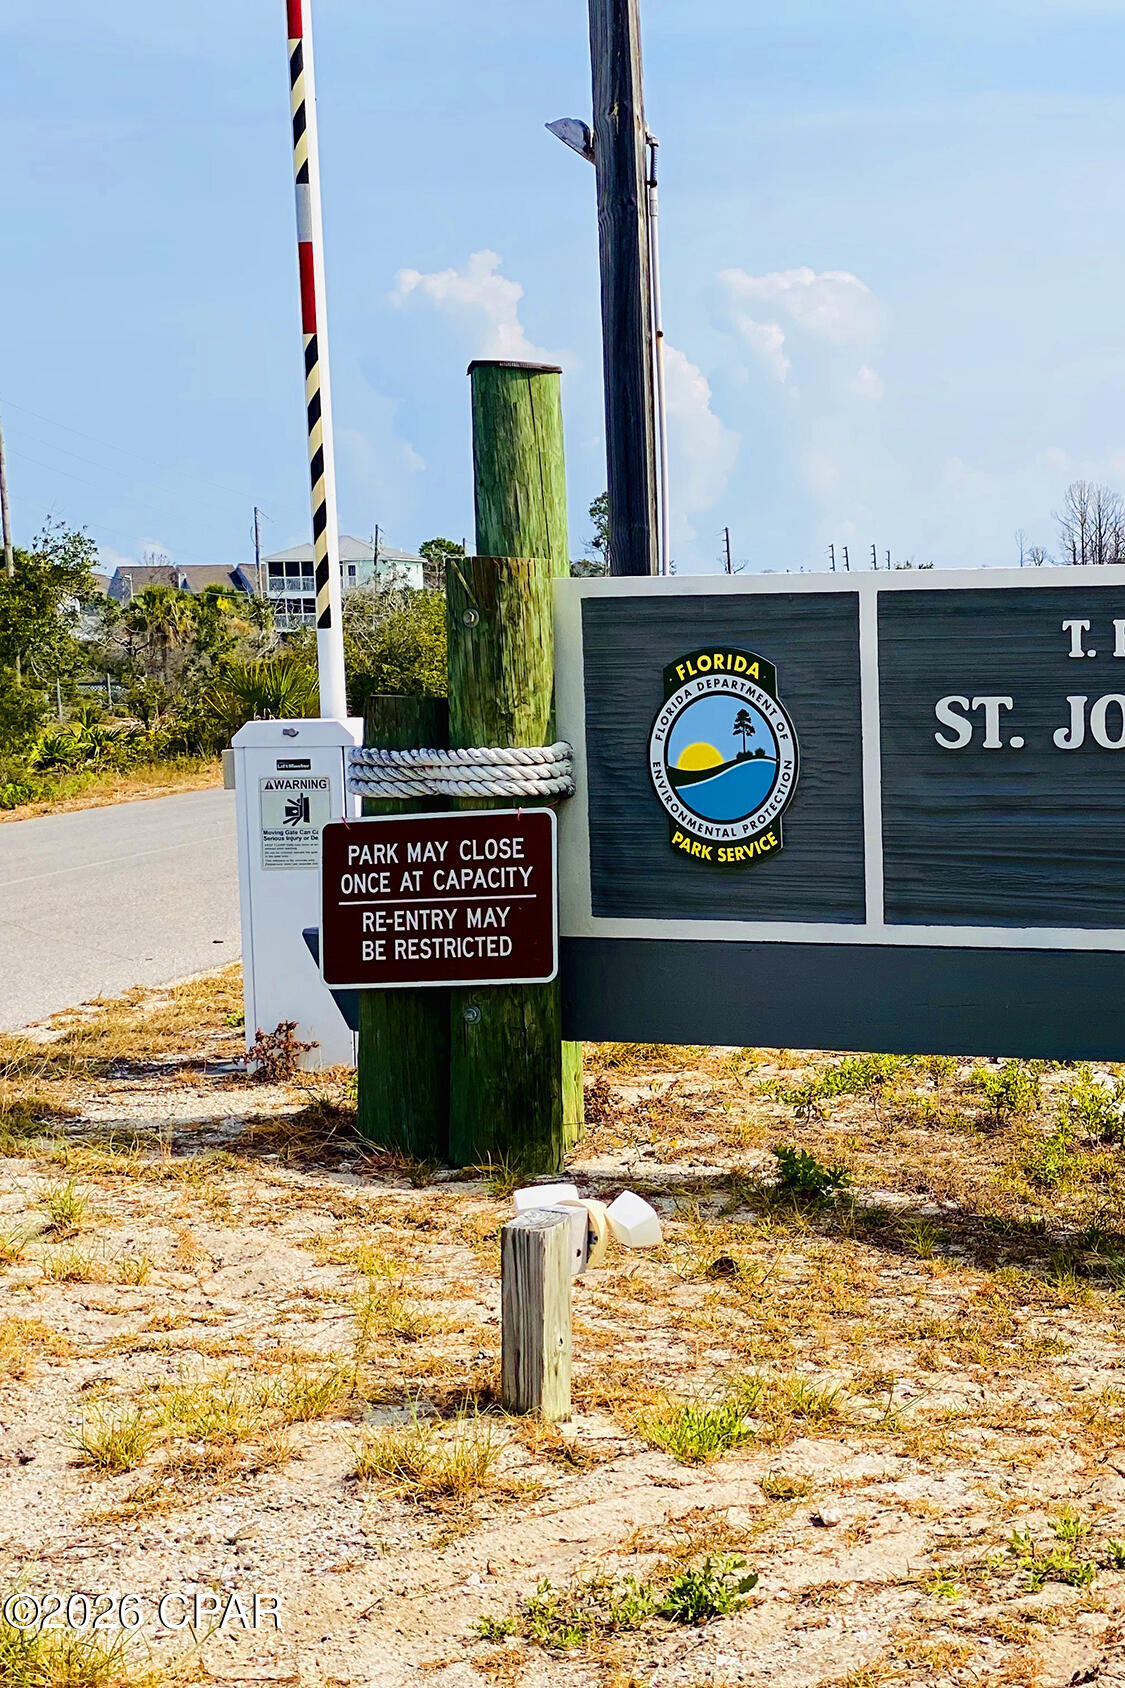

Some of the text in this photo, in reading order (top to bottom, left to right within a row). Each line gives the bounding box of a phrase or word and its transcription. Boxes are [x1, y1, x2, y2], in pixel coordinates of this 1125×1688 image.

[1062, 619, 1096, 658] T.
[675, 653, 760, 681] FLORIDA
[655, 678, 789, 742] FLORIDA DEPARTMENT OF
[934, 695, 1025, 749] ST.
[274, 779, 327, 790] WARNING
[652, 760, 793, 838] ENVIRONMENTAL PROTECTION
[348, 837, 525, 866] PARK MAY CLOSE
[671, 831, 779, 862] PARK SERVICE
[340, 866, 533, 894] ONCE AT CAPACITY
[362, 906, 511, 932] RE-ENTRY MAY
[362, 935, 513, 961] BE RESTRICTED
